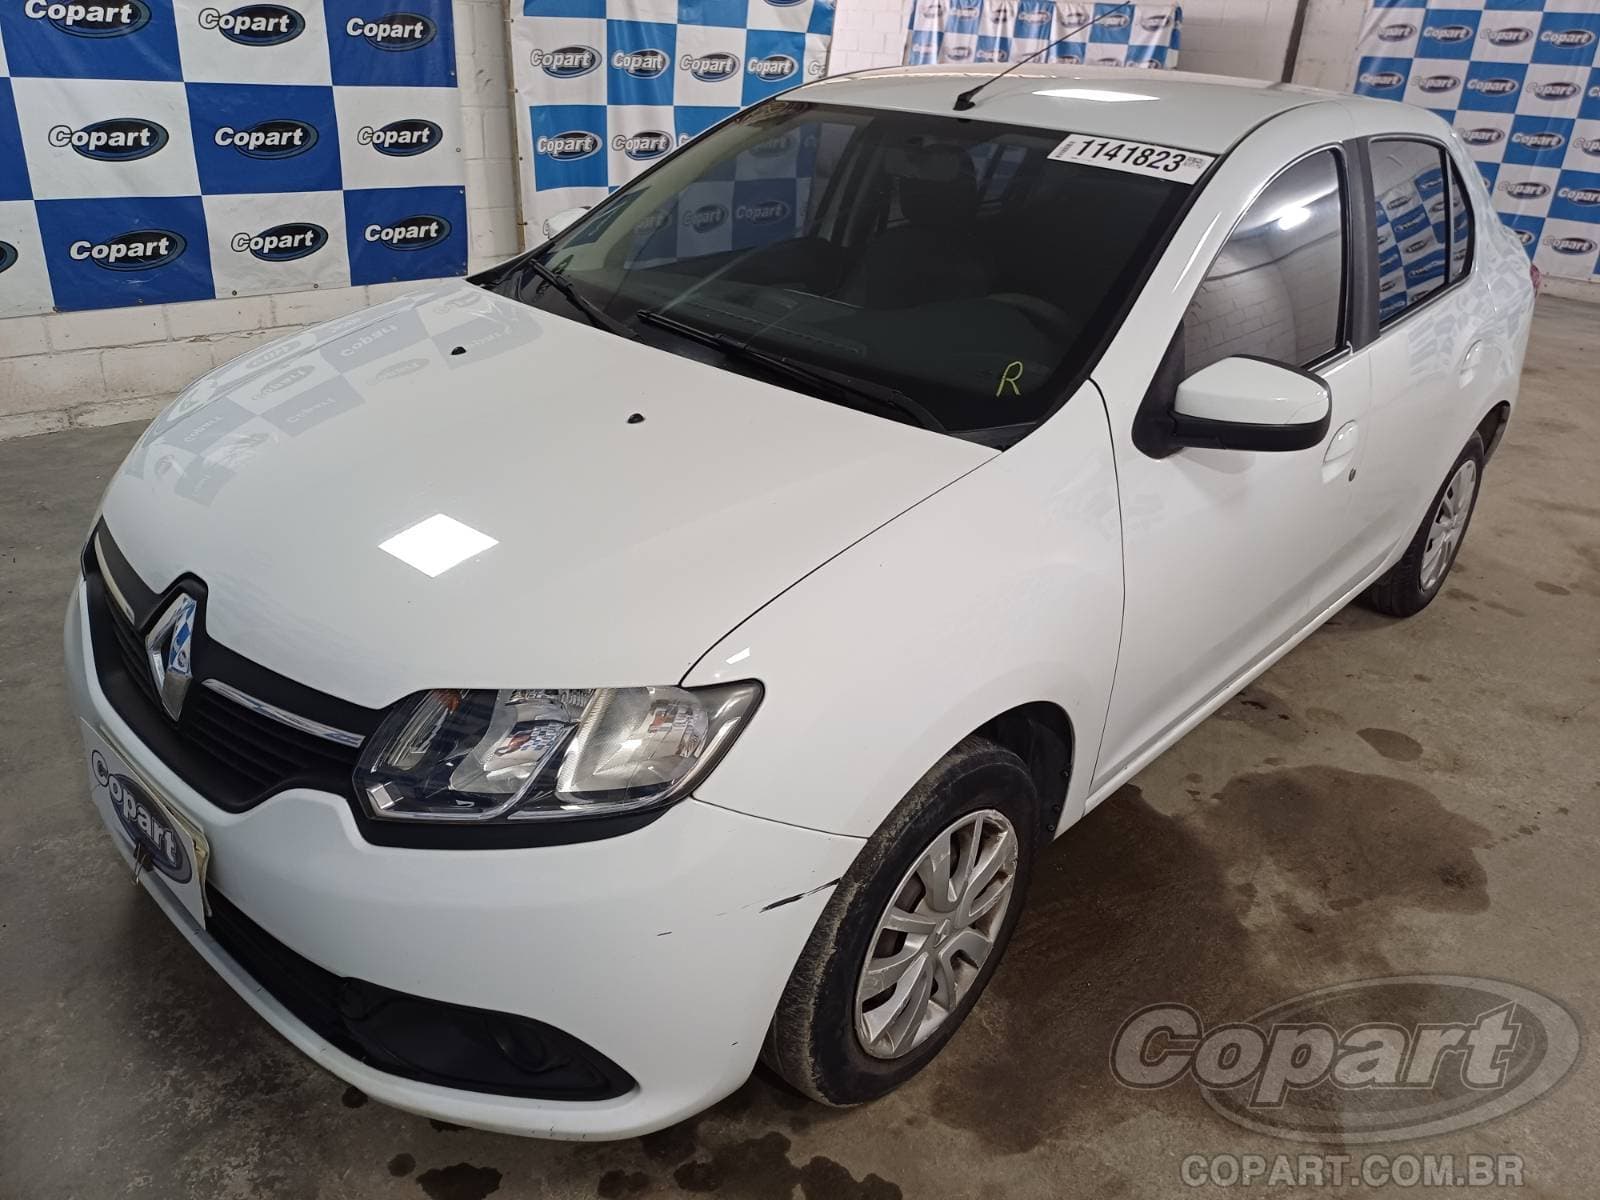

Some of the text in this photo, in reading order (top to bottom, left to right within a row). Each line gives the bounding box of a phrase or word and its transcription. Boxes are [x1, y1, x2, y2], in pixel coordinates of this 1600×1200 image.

[25, 0, 132, 26] Copart
[199, 8, 290, 34] Copart
[346, 17, 424, 40] Copart
[1424, 26, 1467, 39] Copart
[1541, 30, 1589, 45] Copart
[530, 49, 592, 70] Copart
[611, 50, 663, 71] Copart
[680, 54, 733, 74] Copart
[747, 57, 791, 75] Copart
[1467, 79, 1512, 93] Copart
[1526, 82, 1574, 97] Copart
[48, 125, 151, 151] Copart
[214, 126, 303, 150] Copart
[357, 126, 431, 147] Copart
[537, 137, 593, 156] Copart
[612, 134, 668, 155] Copart
[1512, 132, 1559, 147] Copart
[1077, 139, 1186, 172] 1141823
[1498, 181, 1544, 197] Copart
[735, 204, 783, 221] Copart
[364, 218, 440, 242] Copart
[69, 236, 170, 262] Copart
[231, 228, 315, 254] Copart
[1543, 235, 1590, 252] Copart
[996, 361, 1023, 397] R
[92, 751, 177, 867] Copart
